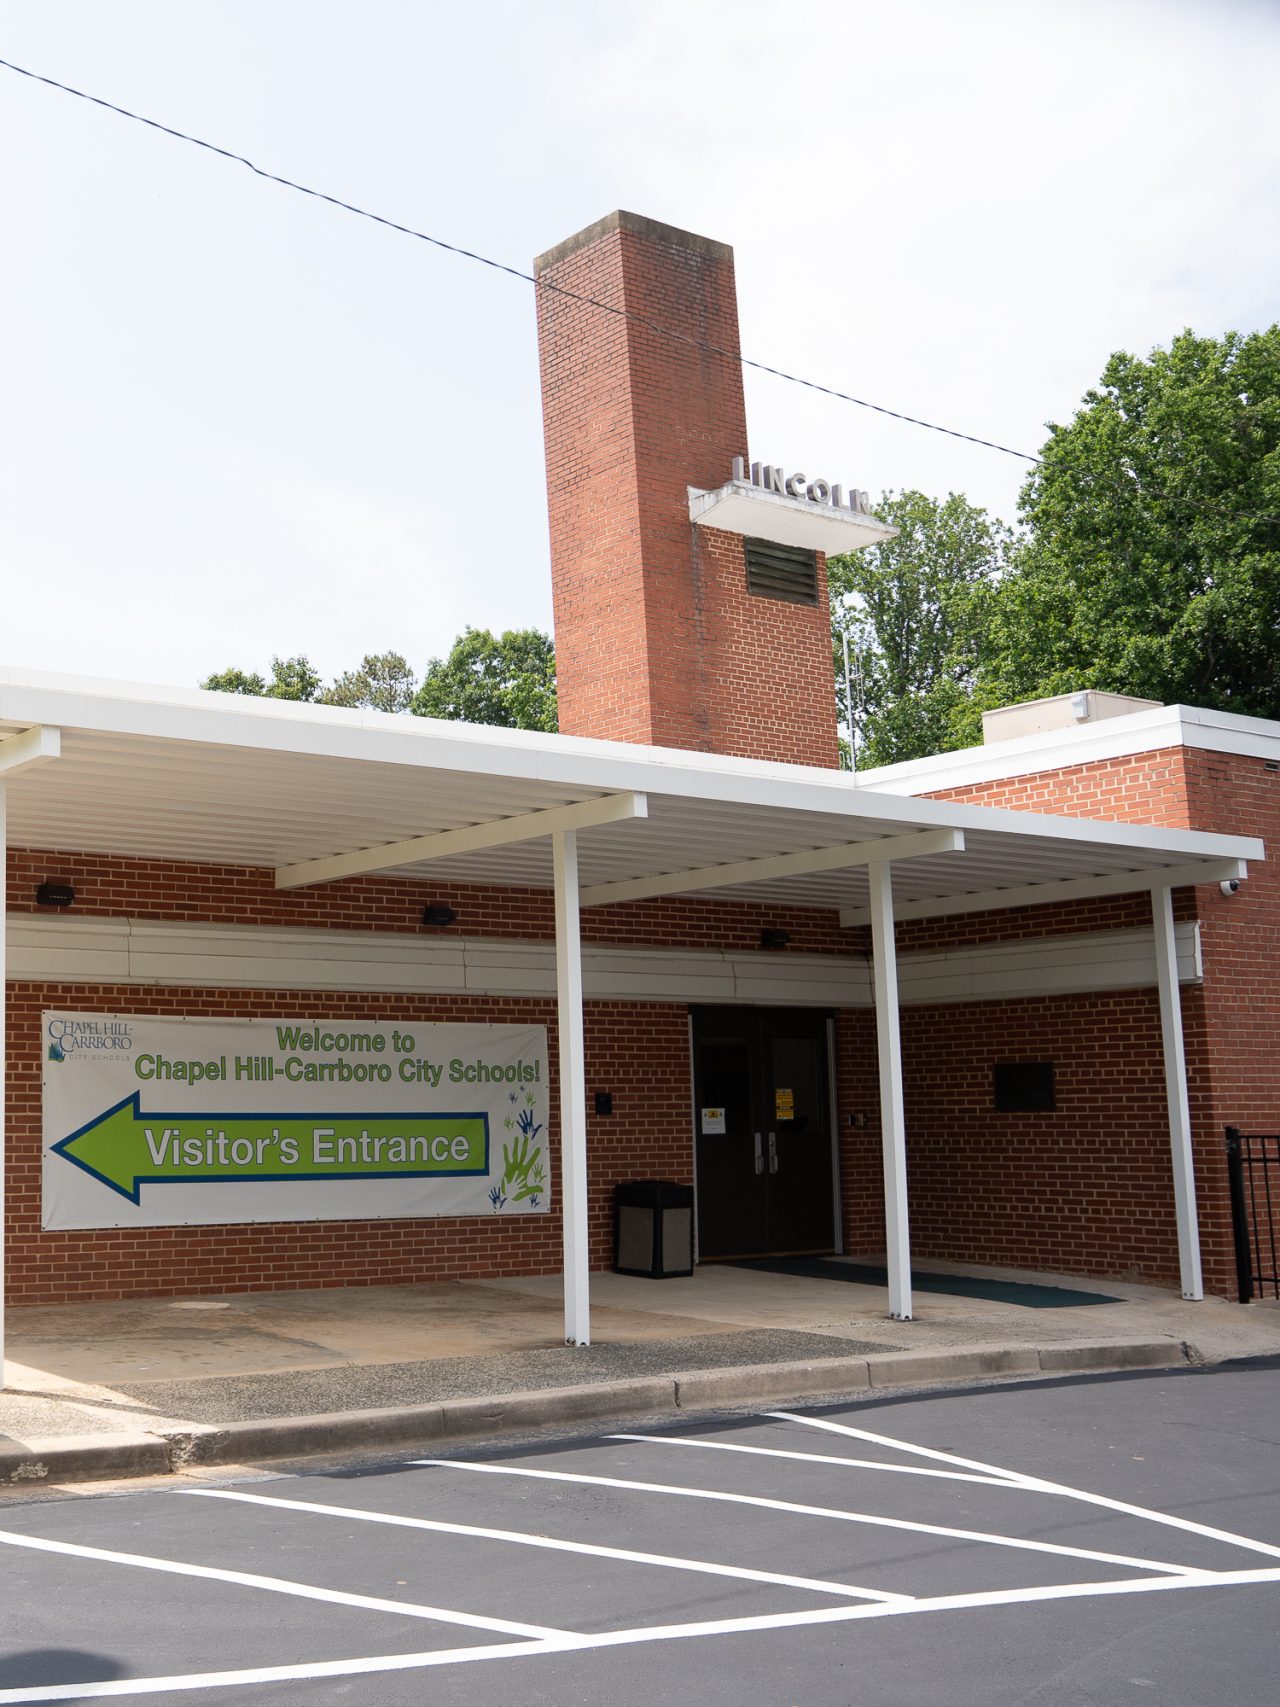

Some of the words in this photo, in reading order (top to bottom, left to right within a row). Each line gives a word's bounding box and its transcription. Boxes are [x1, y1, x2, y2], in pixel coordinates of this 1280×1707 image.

[732, 456, 869, 514] LINCOLN
[48, 1020, 101, 1039] CHAPEL
[59, 1033, 132, 1053] CARRBORO
[276, 1026, 386, 1052] Welcome
[391, 1030, 416, 1053] to
[92, 1053, 131, 1061] SCHOOLS
[134, 1053, 227, 1086] Chapel
[234, 1055, 392, 1083] Hill-Carrboro
[398, 1057, 443, 1088] City
[448, 1058, 540, 1083] Schools!
[143, 1128, 300, 1167] Visitor's
[312, 1127, 471, 1165] Entrance
